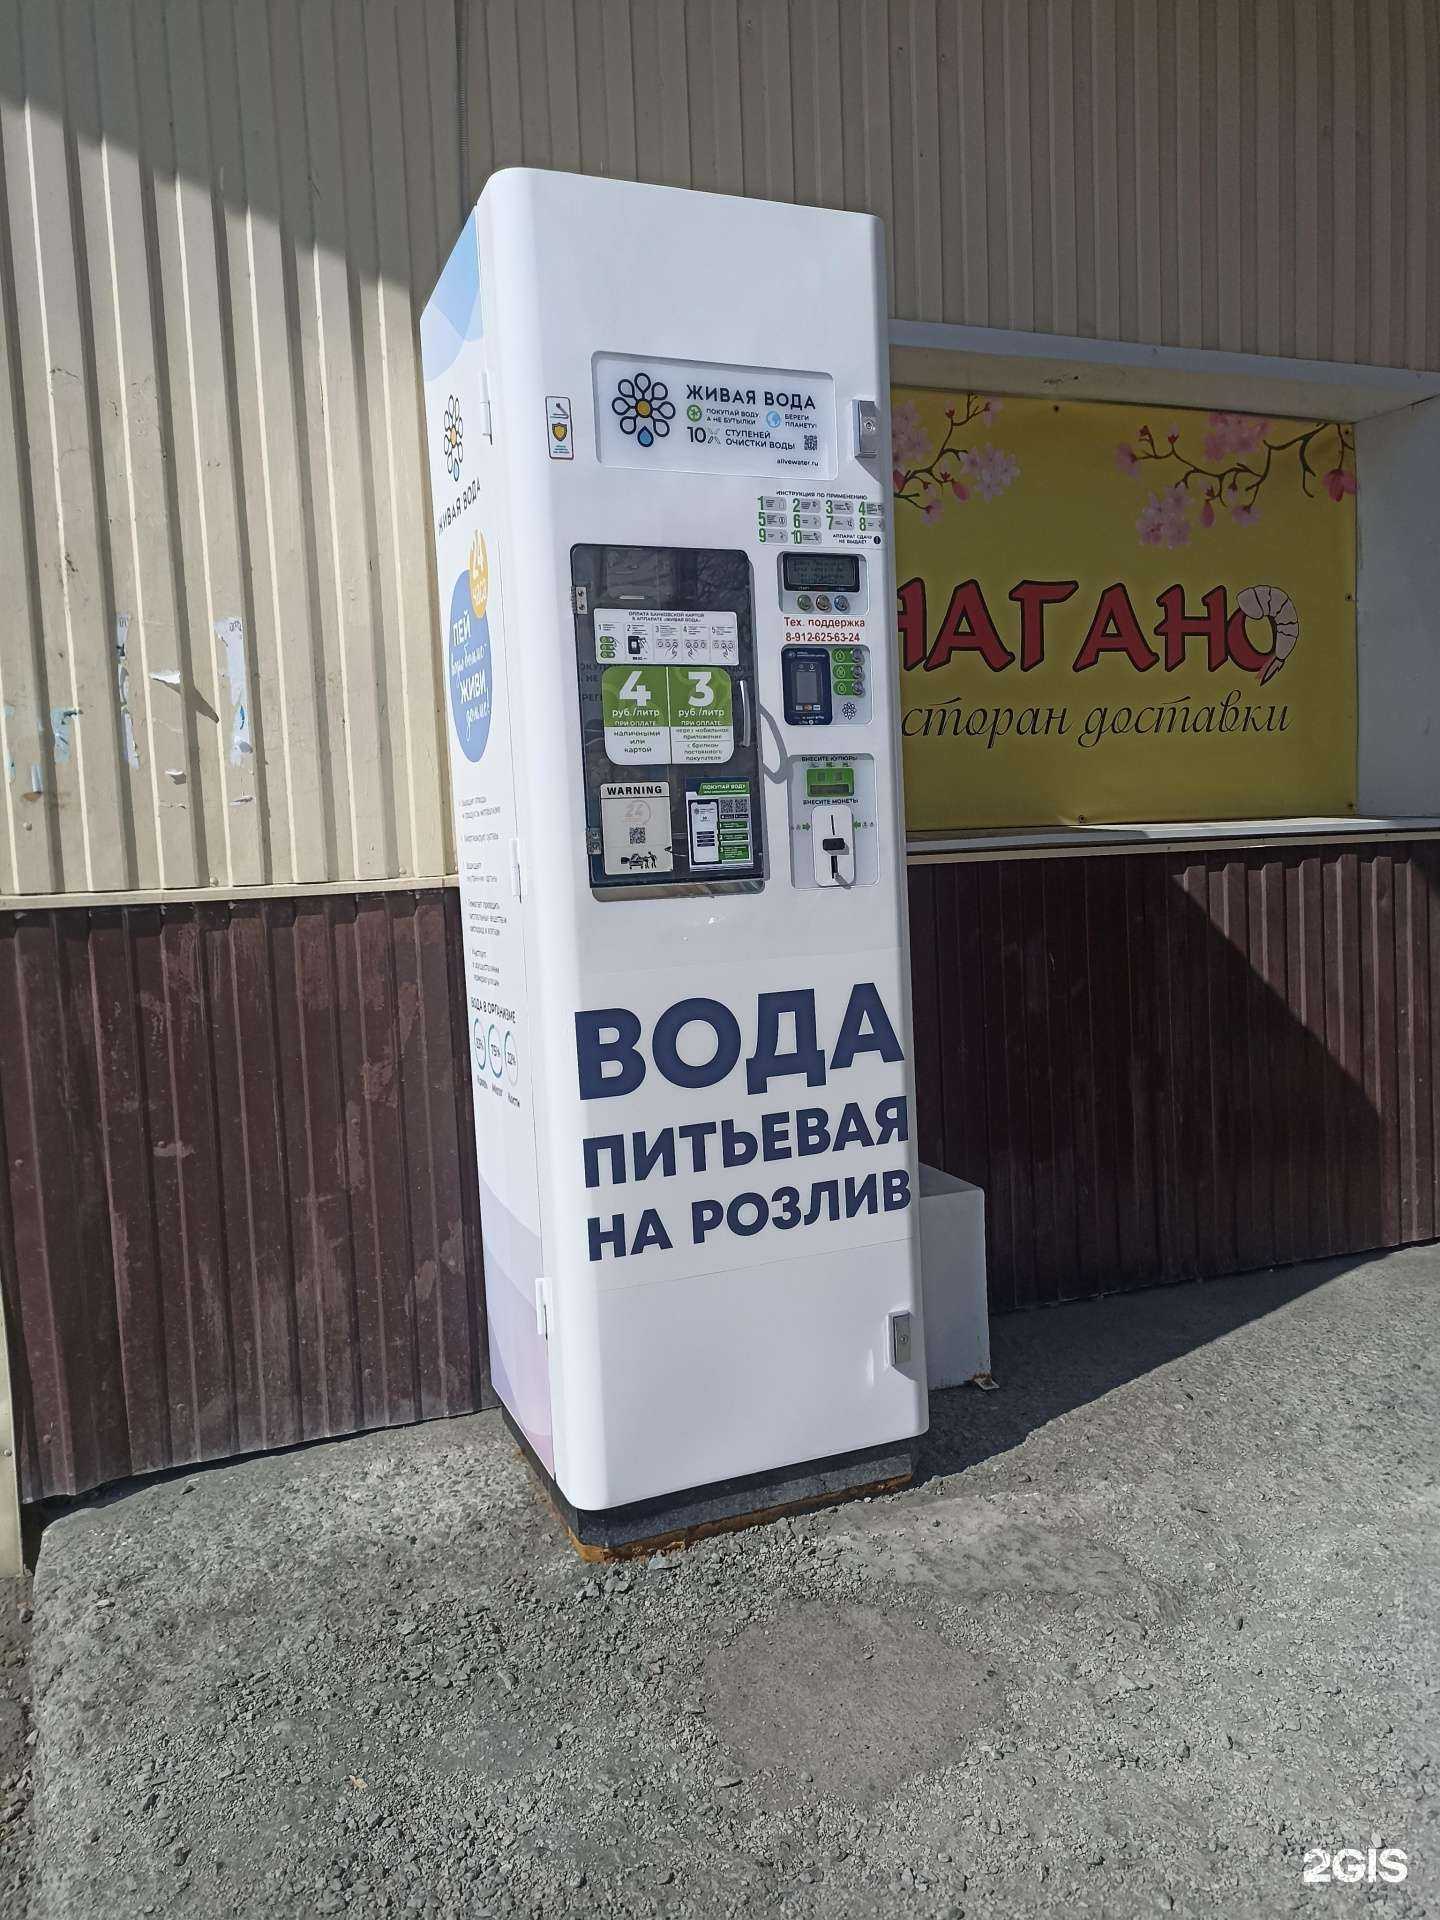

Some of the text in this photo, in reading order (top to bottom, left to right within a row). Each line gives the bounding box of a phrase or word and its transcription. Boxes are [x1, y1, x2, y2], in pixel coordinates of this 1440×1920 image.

[686, 384, 816, 411] ЖИВАЯ ВОДА
[706, 408, 740, 417] ПОКУПАЙ
[784, 413, 810, 421] БЕРЕГИ
[724, 417, 756, 425] БУТЫЛКИ
[686, 426, 706, 444] 10
[725, 428, 771, 440] СТУПЕНЕЙ
[725, 438, 796, 450] ОЧИСТКИ ВОДЫ
[776, 458, 819, 467] alivewater.ru
[438, 478, 481, 537] ЖИВАЯ ВОДА
[757, 496, 764, 510] 1
[792, 498, 800, 513] 2
[826, 500, 833, 514] 3
[858, 501, 866, 516] 4
[758, 512, 766, 527] 5
[794, 514, 801, 528] 6
[826, 516, 834, 530] 7
[860, 517, 866, 532] 8
[759, 528, 766, 543] 9
[791, 530, 802, 544] 10
[453, 610, 472, 647] ПЕЙ
[784, 616, 865, 629] Тех. поддержка
[785, 632, 860, 642] 8-912-625-63-24
[460, 668, 486, 705] ЖИВИ
[619, 670, 651, 706] 4
[688, 672, 714, 707] 3
[612, 708, 660, 718] руб./литр
[678, 708, 725, 718] руб./литр
[1077, 690, 1291, 748] доставки
[624, 746, 652, 754] картой
[606, 785, 663, 796] WARNING
[574, 982, 905, 1100] ВОДА
[582, 1095, 909, 1188] ПИТЬЕВАЯ
[587, 1168, 912, 1262] НА РОЗЛИВ
